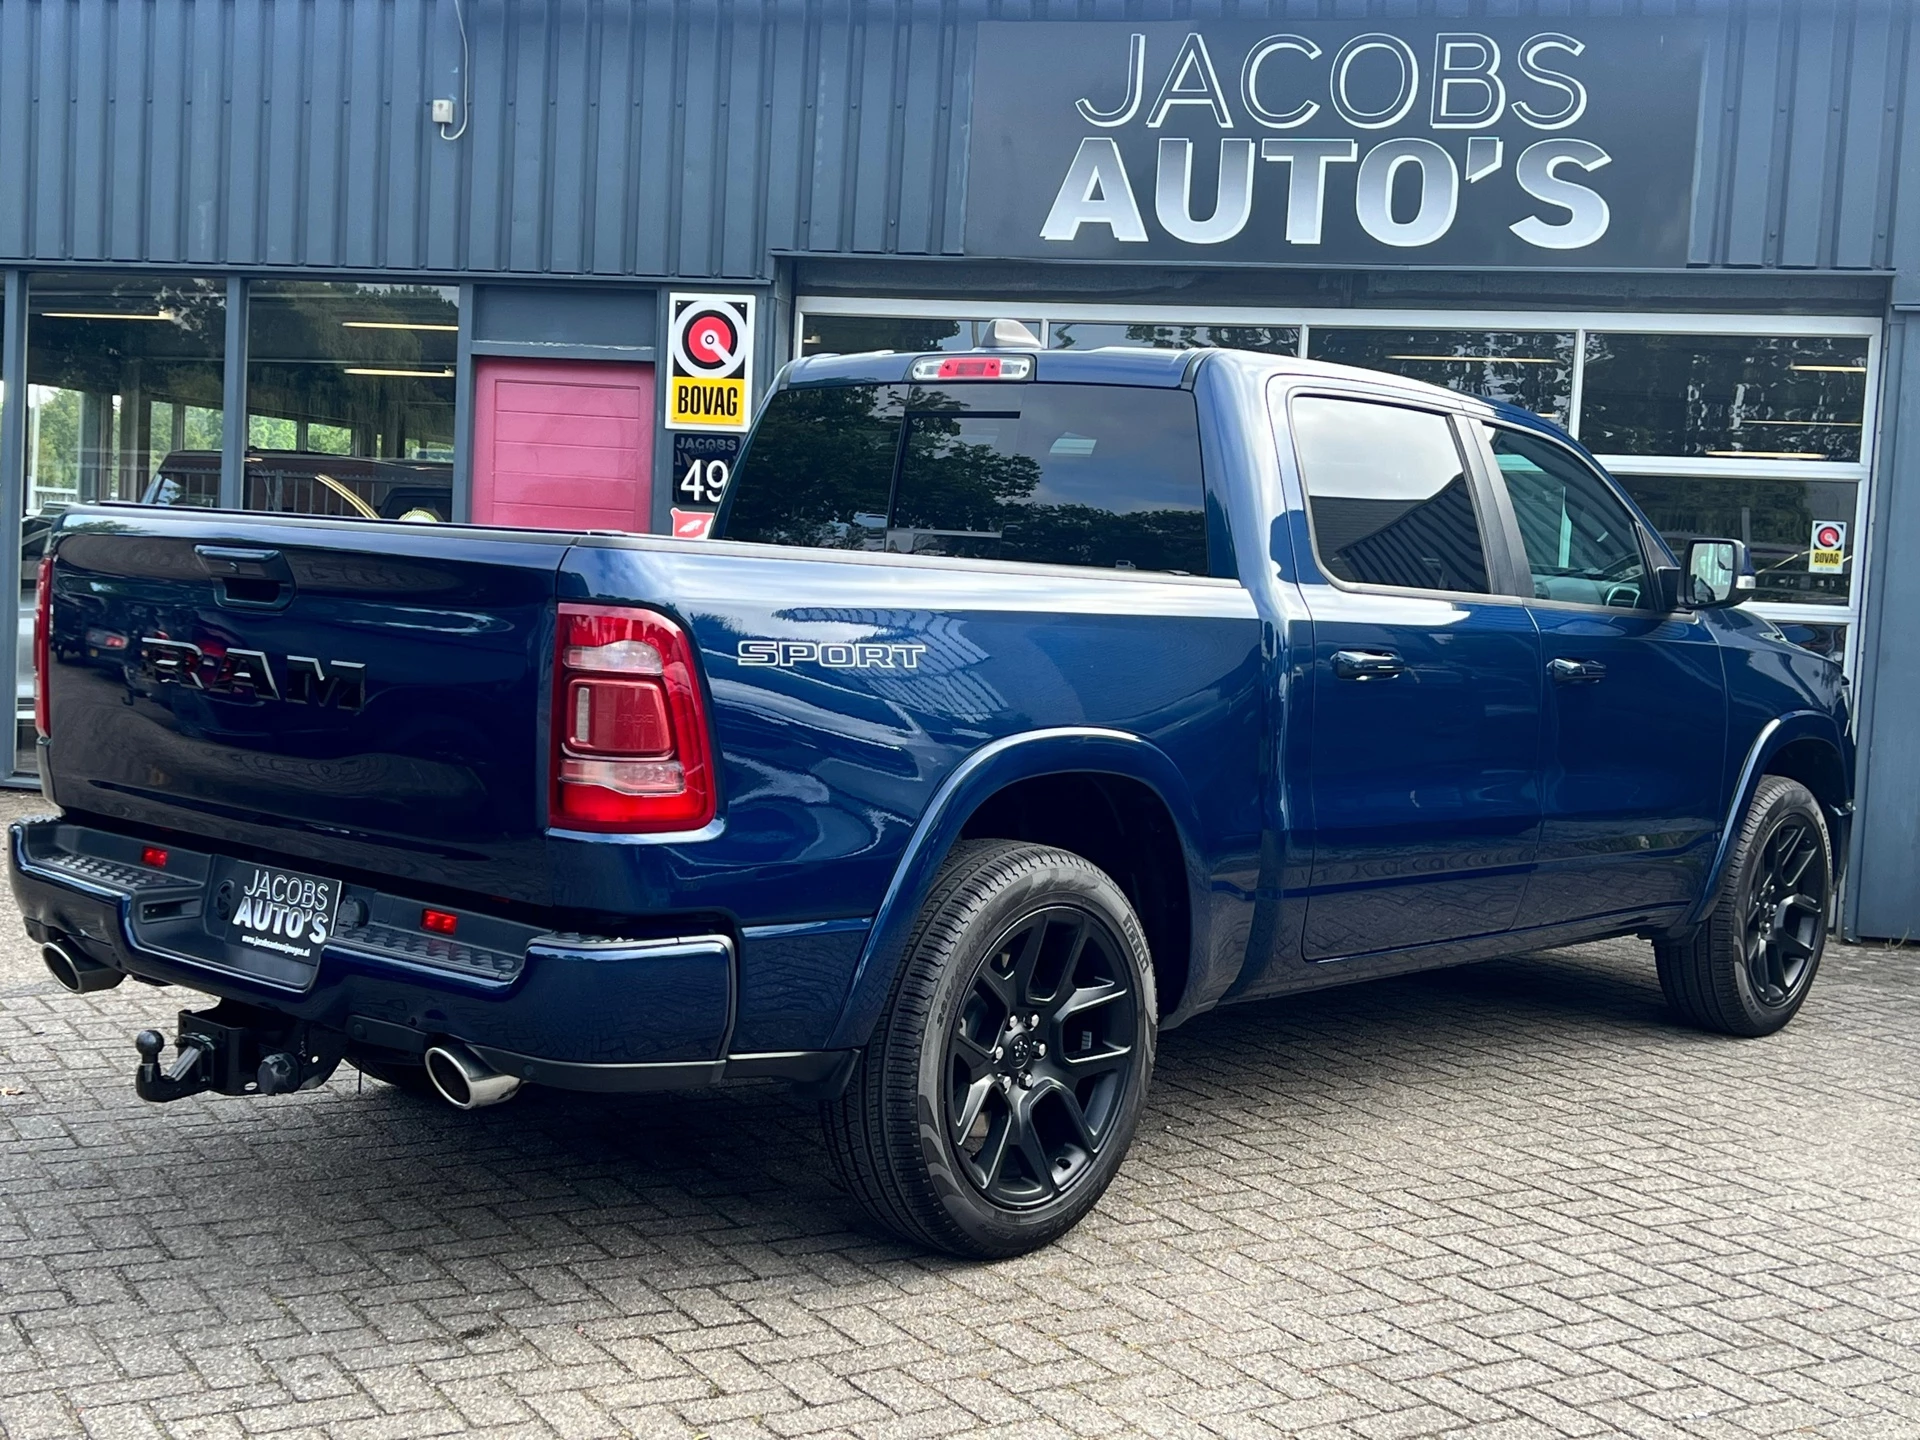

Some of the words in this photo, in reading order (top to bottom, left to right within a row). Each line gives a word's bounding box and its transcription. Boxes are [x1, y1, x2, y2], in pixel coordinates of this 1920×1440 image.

[1075, 32, 1587, 129] JACOBS
[1040, 137, 1612, 249] AUTO'S
[677, 385, 738, 417] BOVAG
[676, 437, 737, 451] JACOBS
[680, 459, 729, 503] 49
[1814, 552, 1839, 565] BOVAG
[141, 636, 366, 711] RAM
[737, 640, 926, 669] SPORT
[244, 869, 329, 911] JACOBS
[232, 896, 329, 945] AUTO'S
